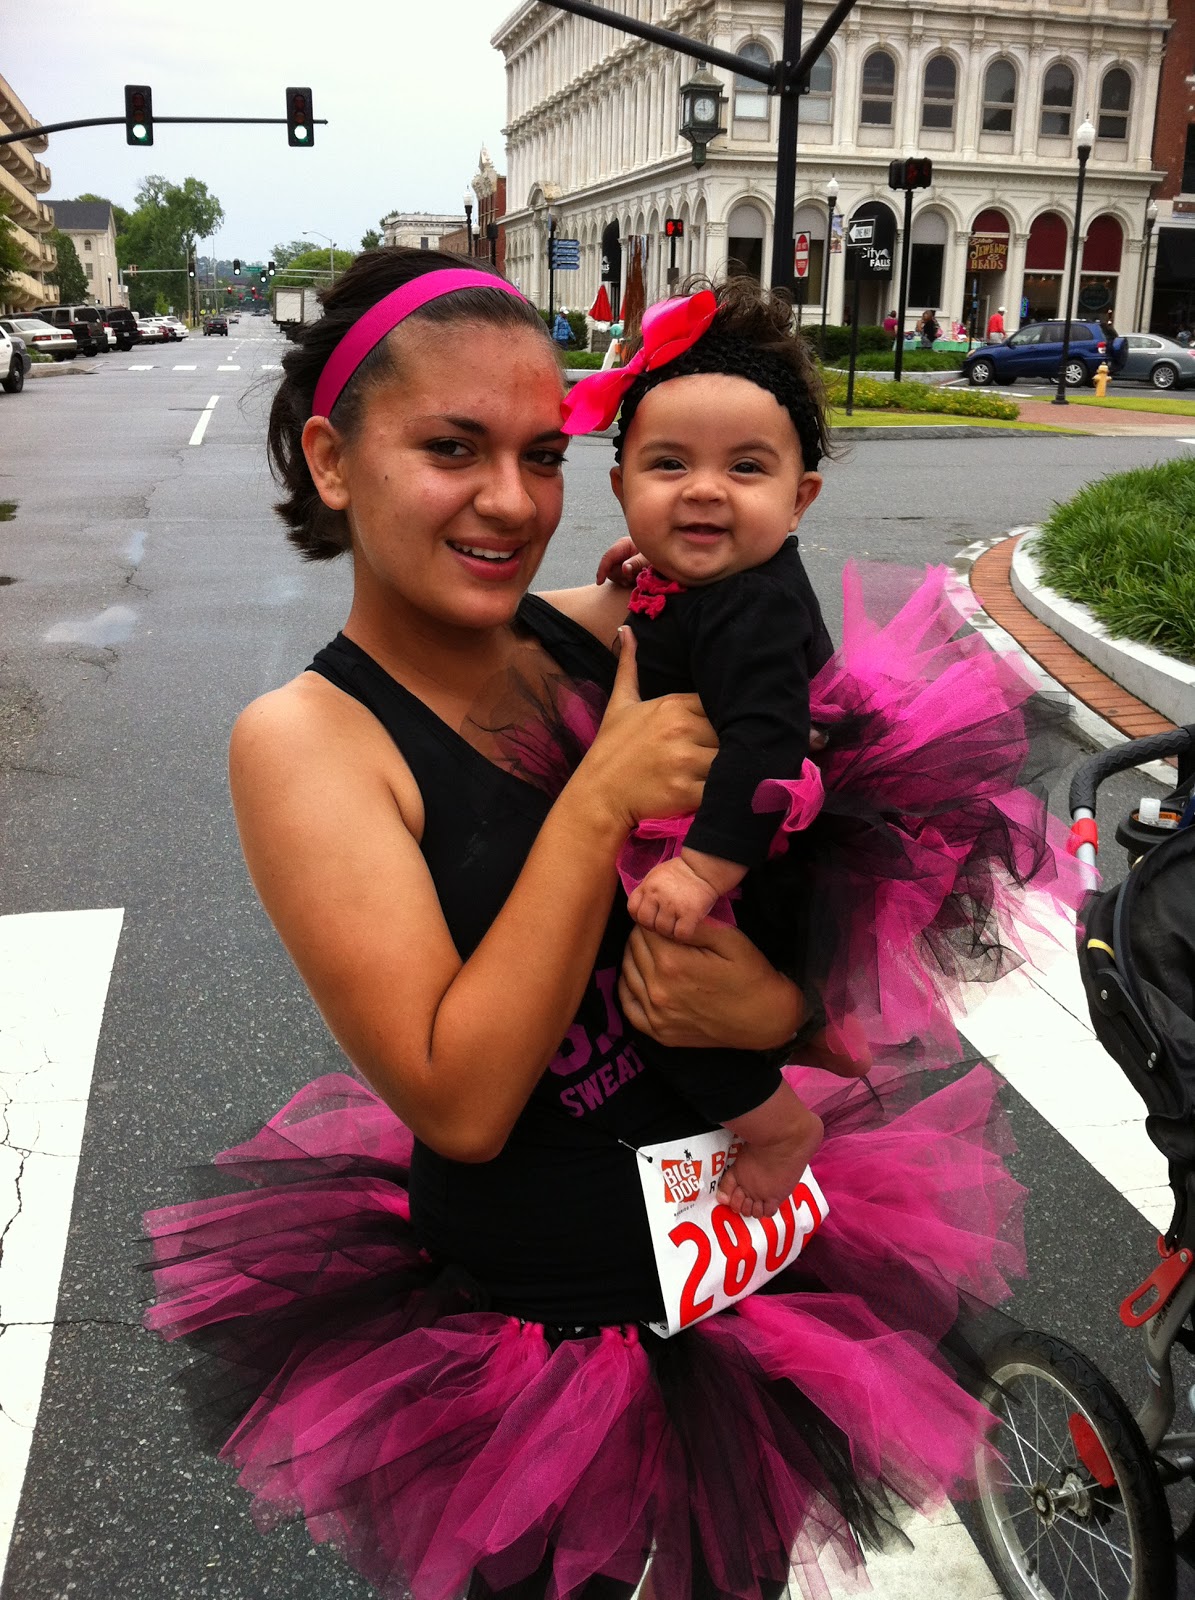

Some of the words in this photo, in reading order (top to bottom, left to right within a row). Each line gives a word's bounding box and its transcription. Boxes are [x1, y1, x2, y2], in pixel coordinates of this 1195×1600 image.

[870, 259, 891, 267] FALLS
[971, 260, 1003, 270] BEADS
[663, 1160, 695, 1188] BIG
[670, 1175, 700, 1203] DOG
